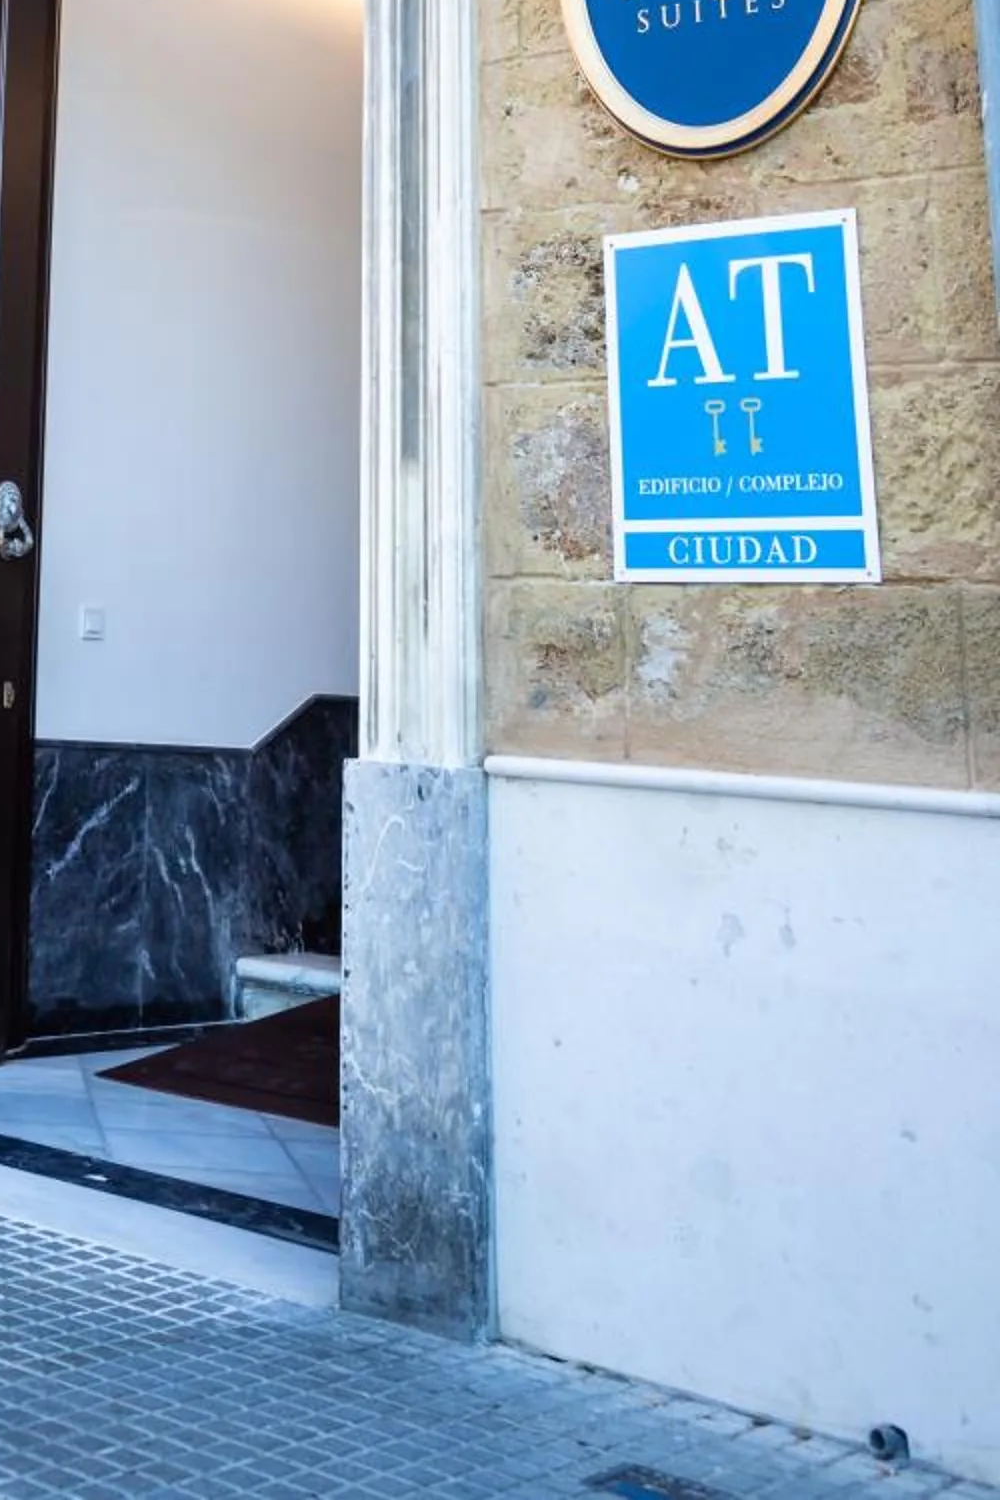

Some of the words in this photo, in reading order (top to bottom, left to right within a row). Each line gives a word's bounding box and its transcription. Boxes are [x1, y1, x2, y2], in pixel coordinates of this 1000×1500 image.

[648, 253, 815, 387] AT
[639, 476, 721, 495] EDIFICIO
[739, 473, 843, 493] COMPLEJO
[668, 535, 818, 565] CIUDAD
